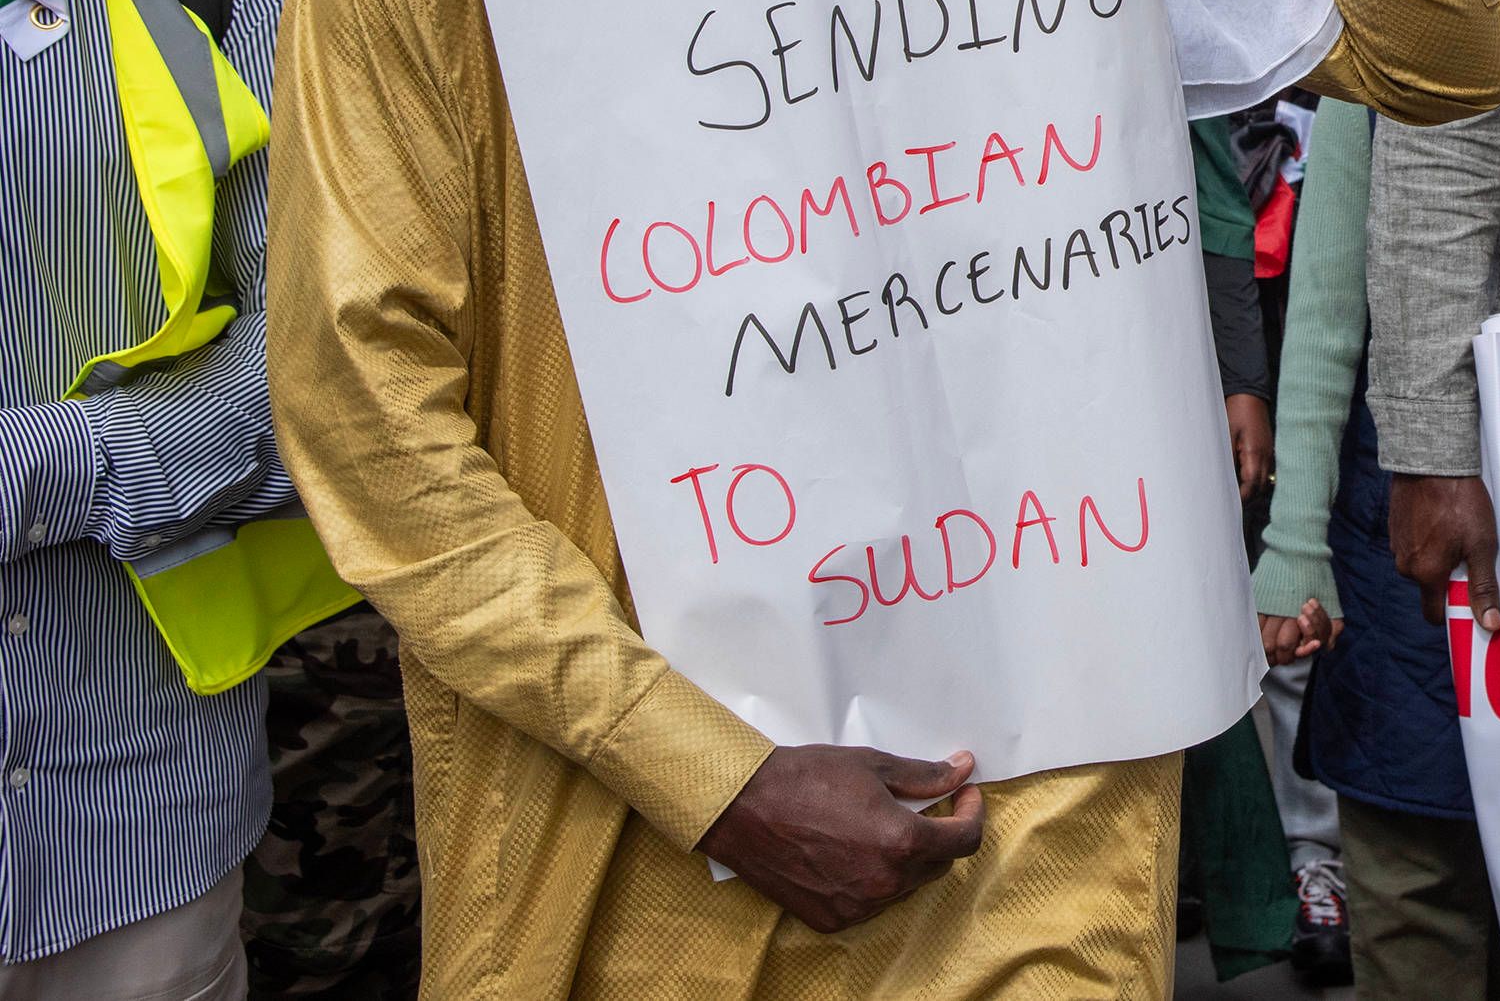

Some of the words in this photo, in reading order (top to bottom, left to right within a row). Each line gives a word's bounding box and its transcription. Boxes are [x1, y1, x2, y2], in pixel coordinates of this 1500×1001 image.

[600, 114, 1101, 304] COLOMBIAN
[724, 195, 1192, 398] MERCENARIES
[670, 463, 797, 565] TO
[807, 476, 1149, 626] SUDAN
